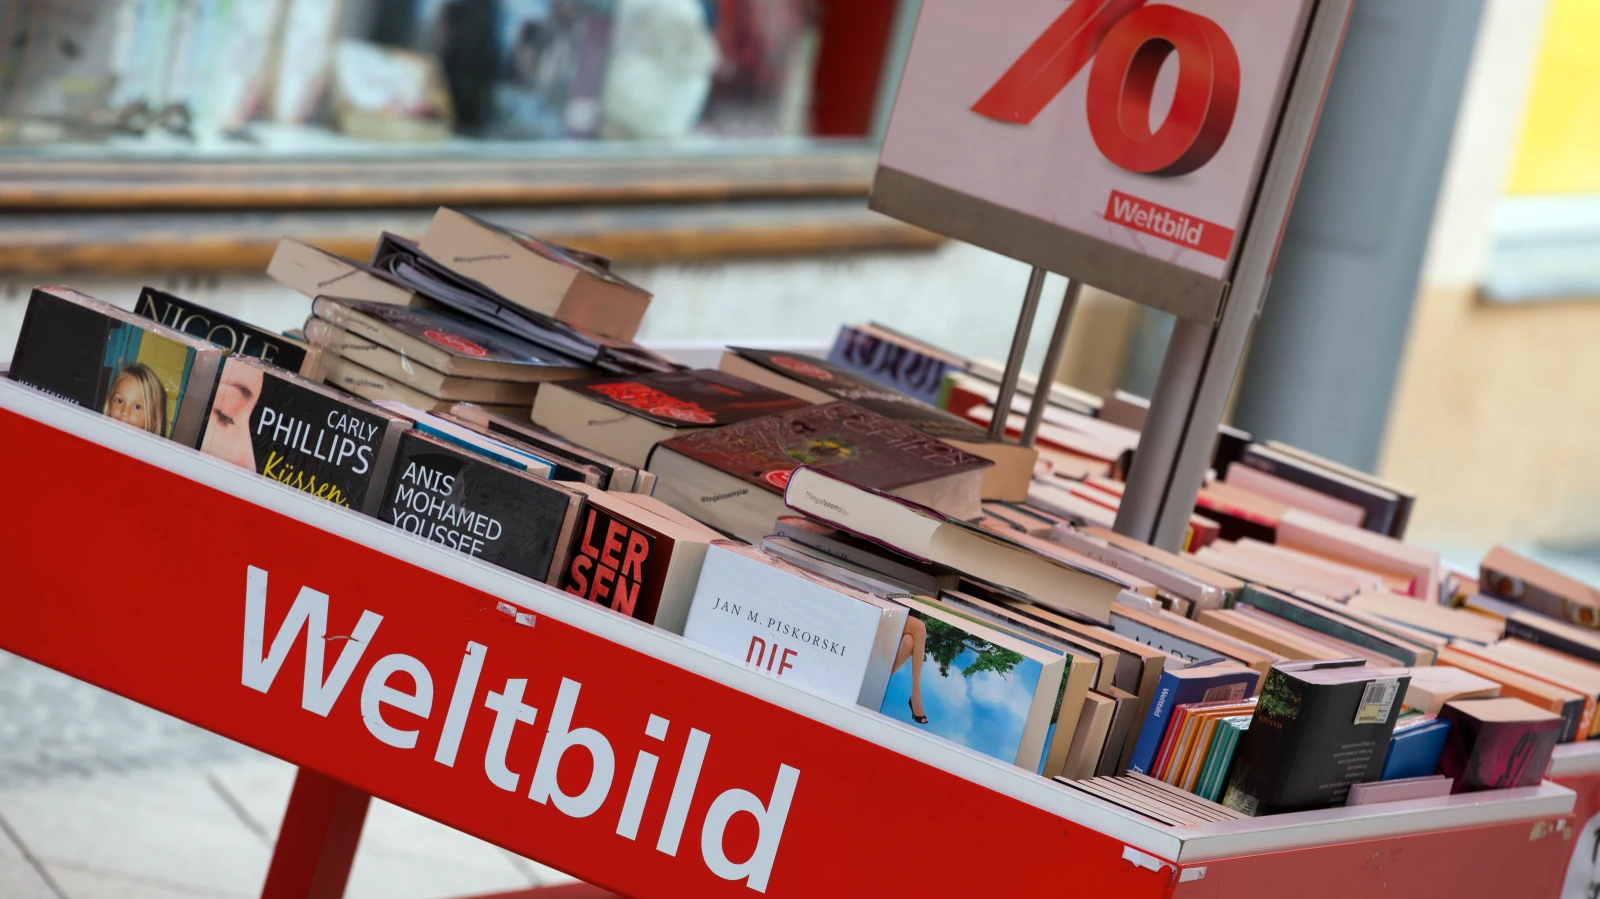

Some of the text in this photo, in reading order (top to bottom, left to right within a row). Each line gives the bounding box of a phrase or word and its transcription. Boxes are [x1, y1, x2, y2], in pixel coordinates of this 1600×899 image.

[1113, 196, 1203, 245] Weltbild
[257, 406, 372, 475] PHILLIPS
[327, 410, 378, 442] CARLY
[402, 461, 456, 497] ANIS
[393, 507, 485, 558] YOUSSEF
[395, 483, 503, 541] MOHAMED
[580, 508, 650, 582] LER
[565, 554, 641, 618] SEN
[713, 597, 847, 657] JAN M. PISKORSKI
[241, 564, 801, 894] Weltbild
[1153, 687, 1169, 717] Weltbild
